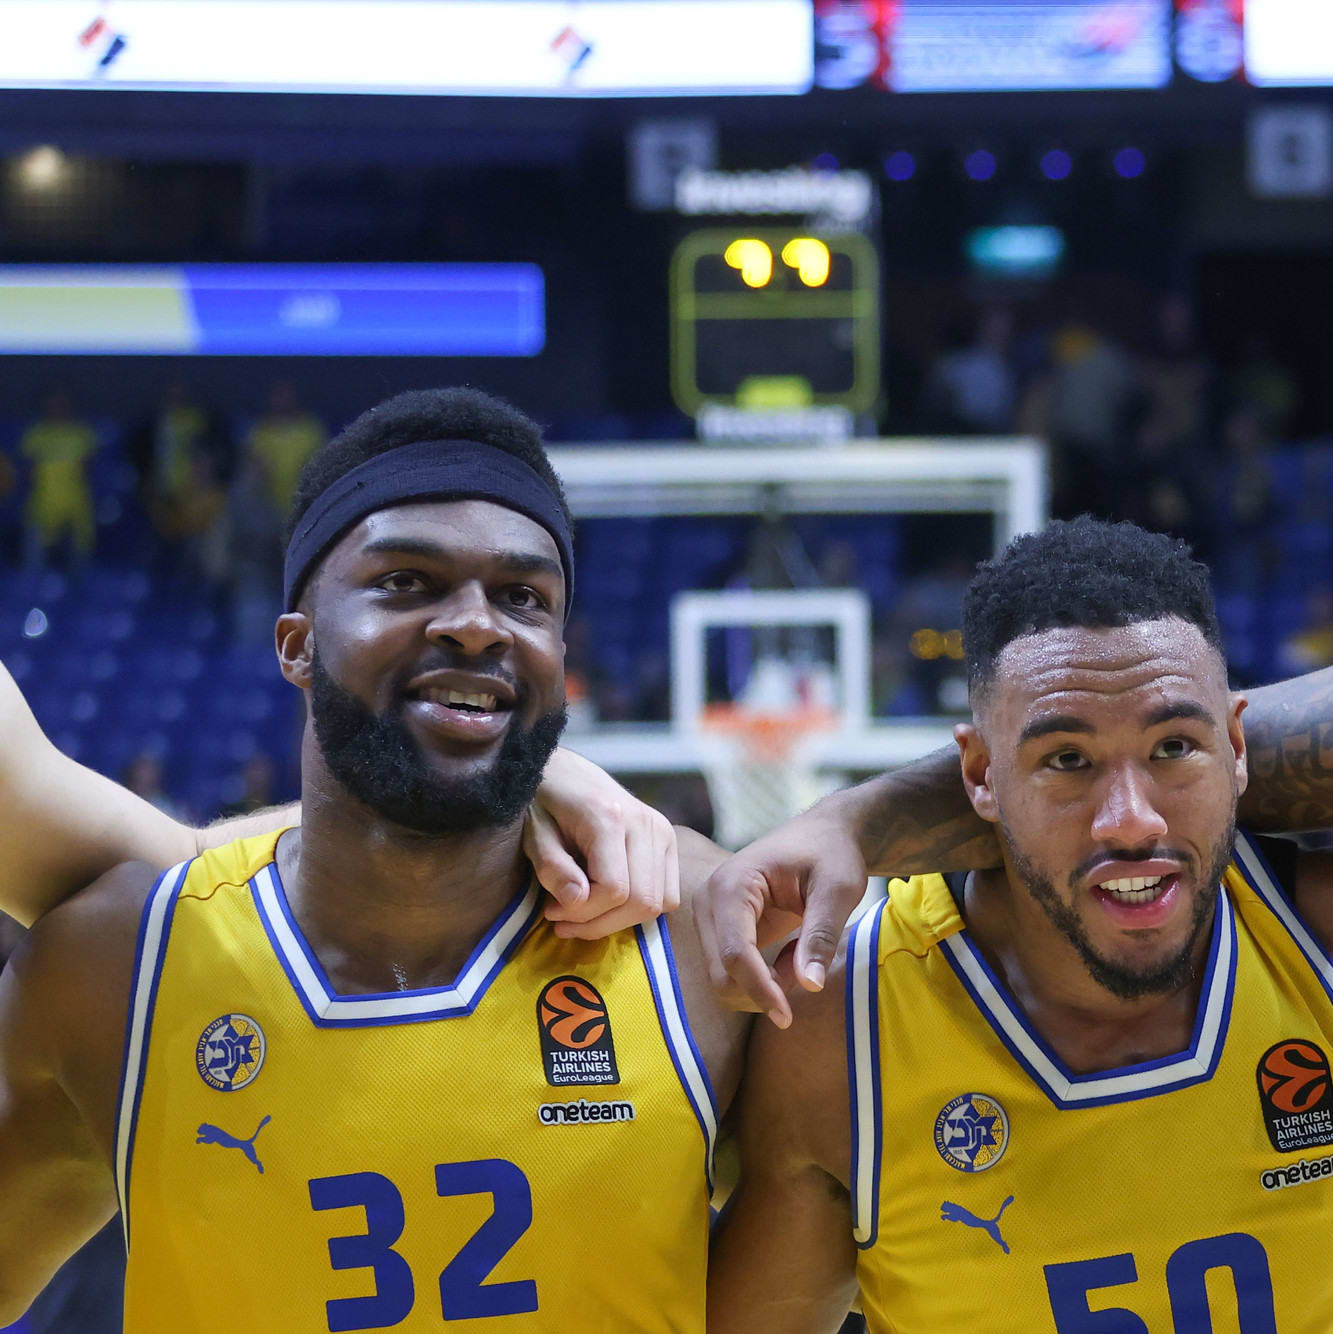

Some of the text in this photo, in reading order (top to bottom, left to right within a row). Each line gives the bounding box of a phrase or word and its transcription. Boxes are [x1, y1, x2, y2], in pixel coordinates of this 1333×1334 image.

[550, 1050, 609, 1062] TURKISH
[553, 1062, 611, 1073] AIRLINES
[553, 1074, 613, 1082] EuroLeague
[541, 1101, 634, 1122] oneteam
[1273, 1109, 1331, 1129] TURKISH
[1277, 1121, 1333, 1140] AIRLINES
[308, 1158, 539, 1332] 32
